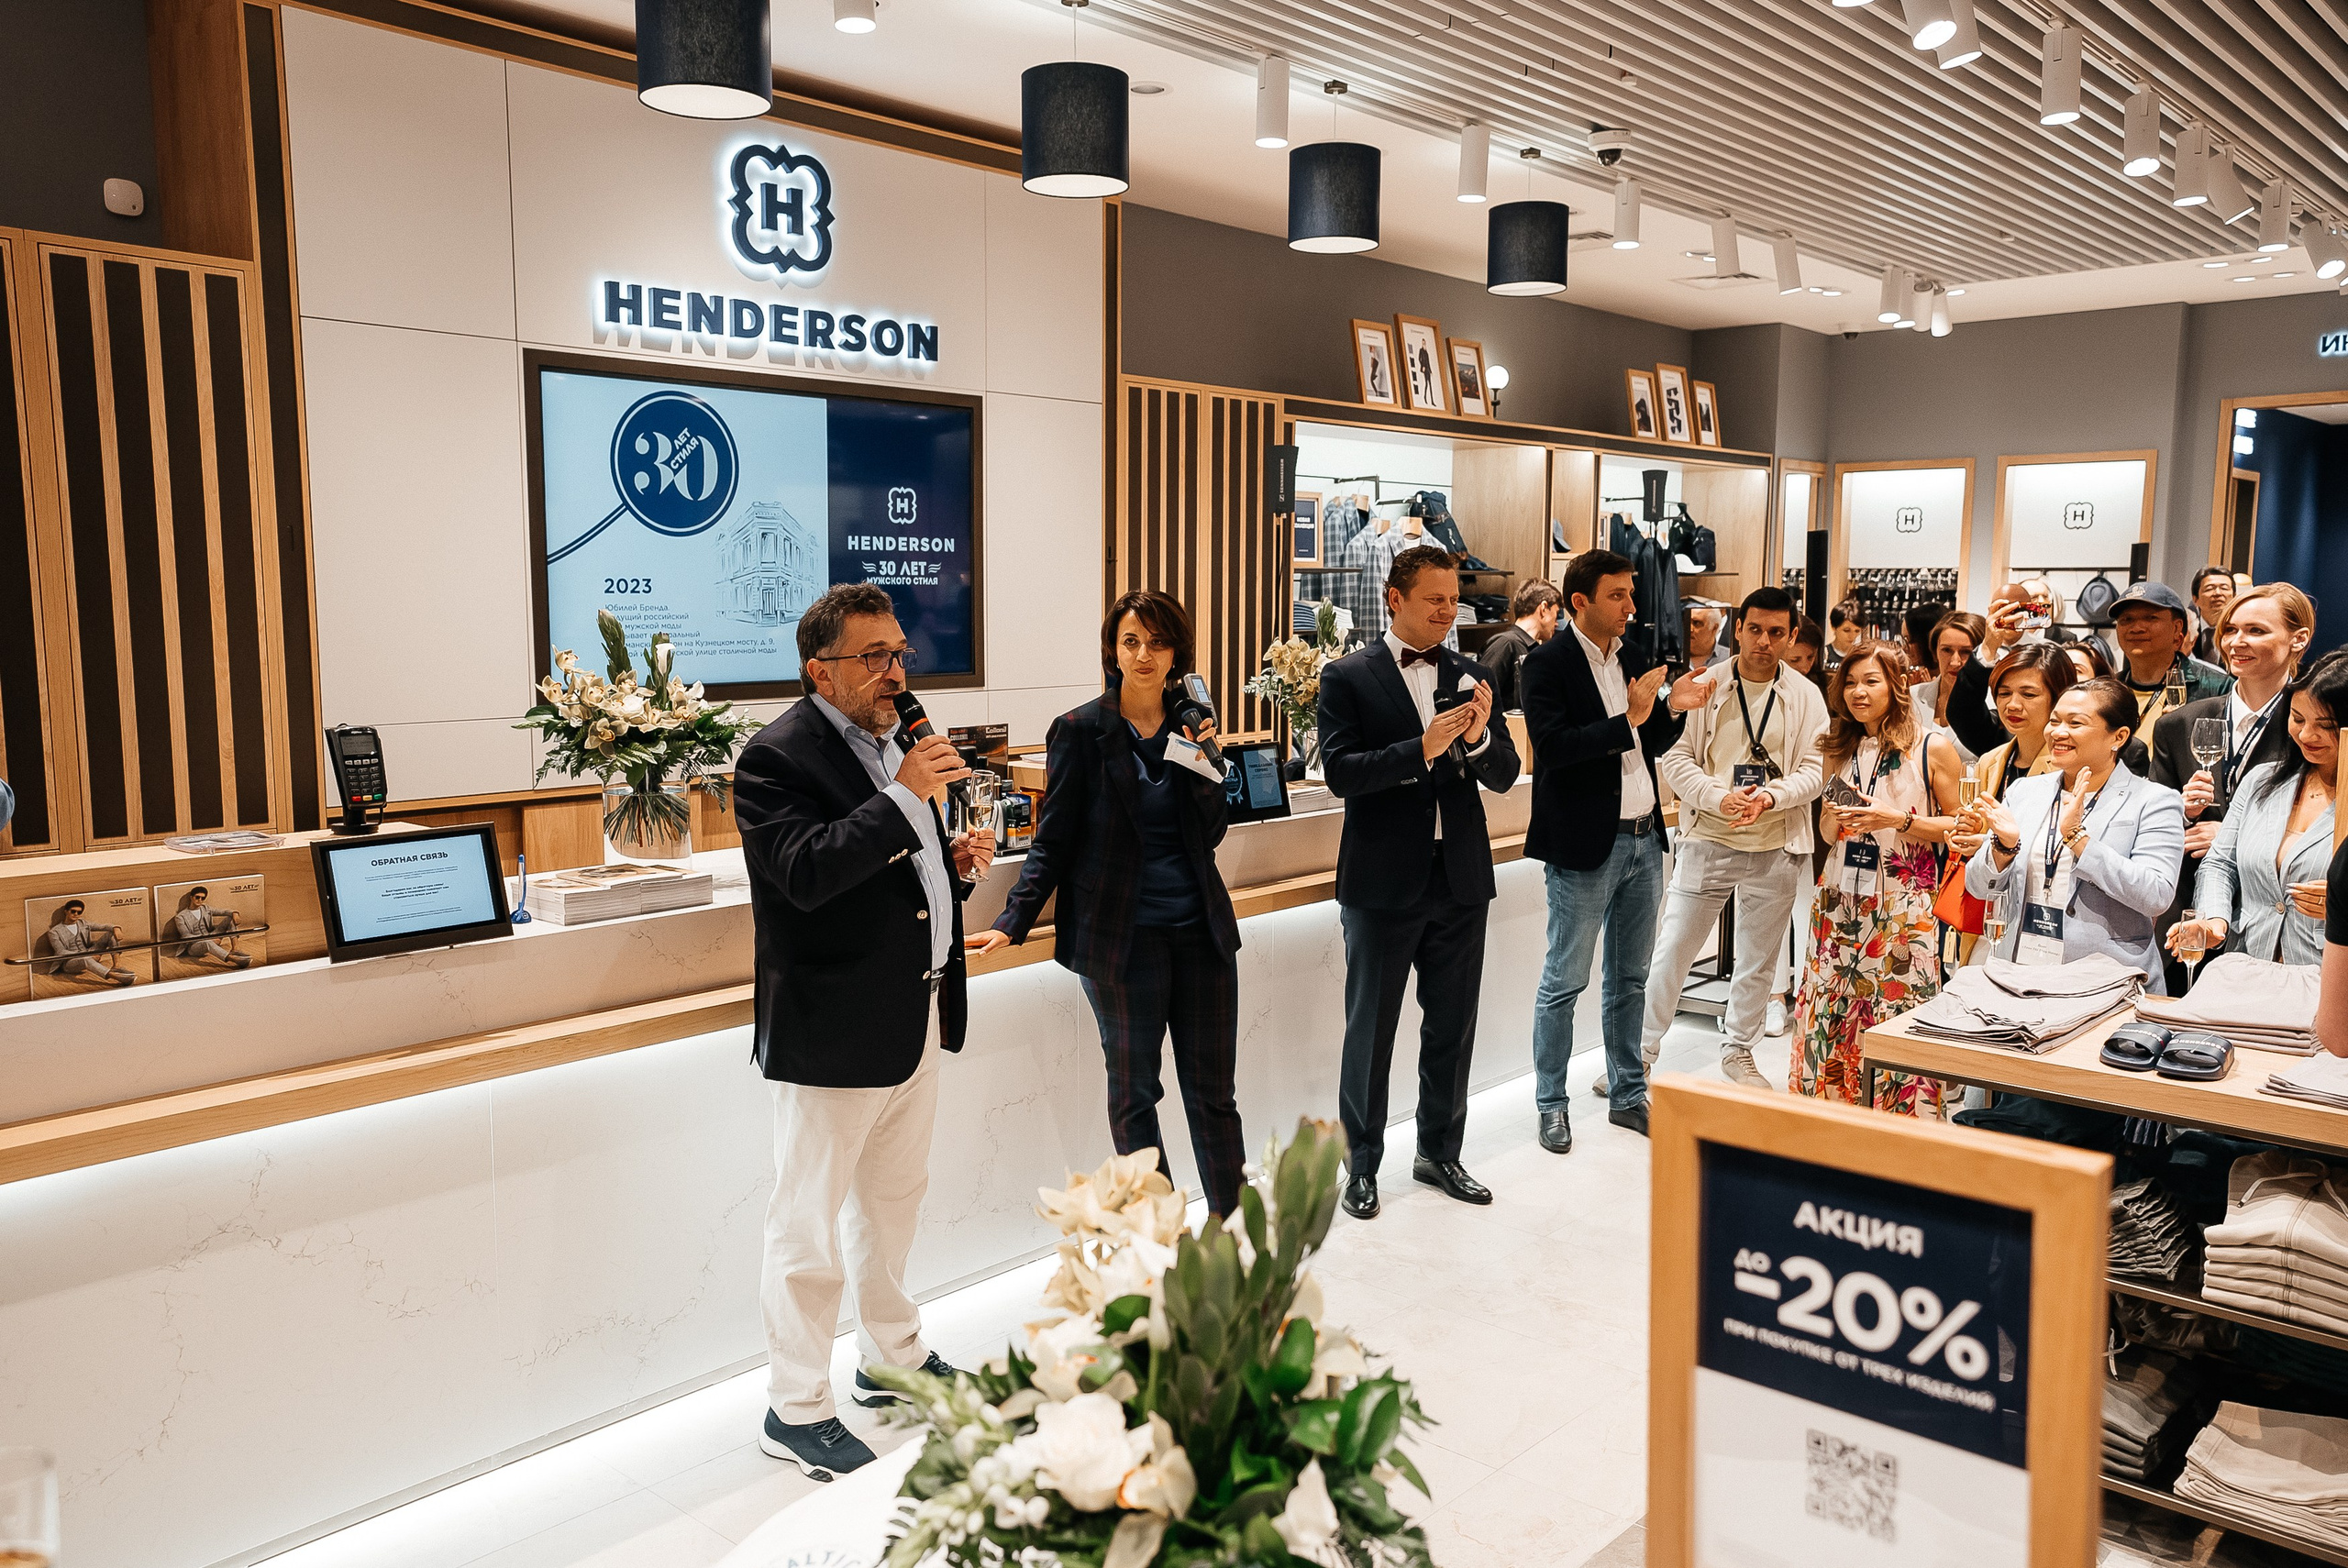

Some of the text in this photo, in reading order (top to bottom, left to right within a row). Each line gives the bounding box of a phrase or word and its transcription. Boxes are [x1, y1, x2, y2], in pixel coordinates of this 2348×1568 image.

[760, 182, 803, 236] H
[604, 281, 939, 362] HENDERSON
[673, 427, 691, 450] ЛЕТ
[670, 436, 699, 469] СТИЛЯ
[634, 431, 718, 501] 30
[896, 498, 909, 513] H
[1904, 514, 1915, 525] H
[2073, 510, 2085, 521] H
[847, 536, 955, 552] HENDERSON
[879, 560, 927, 576] 30 ЛЕТ
[604, 578, 652, 594] 2023
[866, 577, 938, 585] МУЖСКОГО СТИЛЯ
[604, 603, 637, 612] Юбилей
[644, 613, 689, 622] российский
[625, 623, 659, 631] мужской
[695, 639, 735, 647] Кузнецком
[694, 648, 717, 657] улице
[718, 646, 757, 655] столичной
[371, 852, 449, 867] ОБРАТНАЯ СВЯЗЬ
[1793, 1200, 1923, 1259] АКЦИЯ
[1733, 1248, 1772, 1273] ДО
[1756, 1328, 1834, 1365] ПОКУПКЕ
[1834, 1351, 1860, 1373] ОТ
[1905, 1372, 1997, 1414] ИЗДЕЛИЙ
